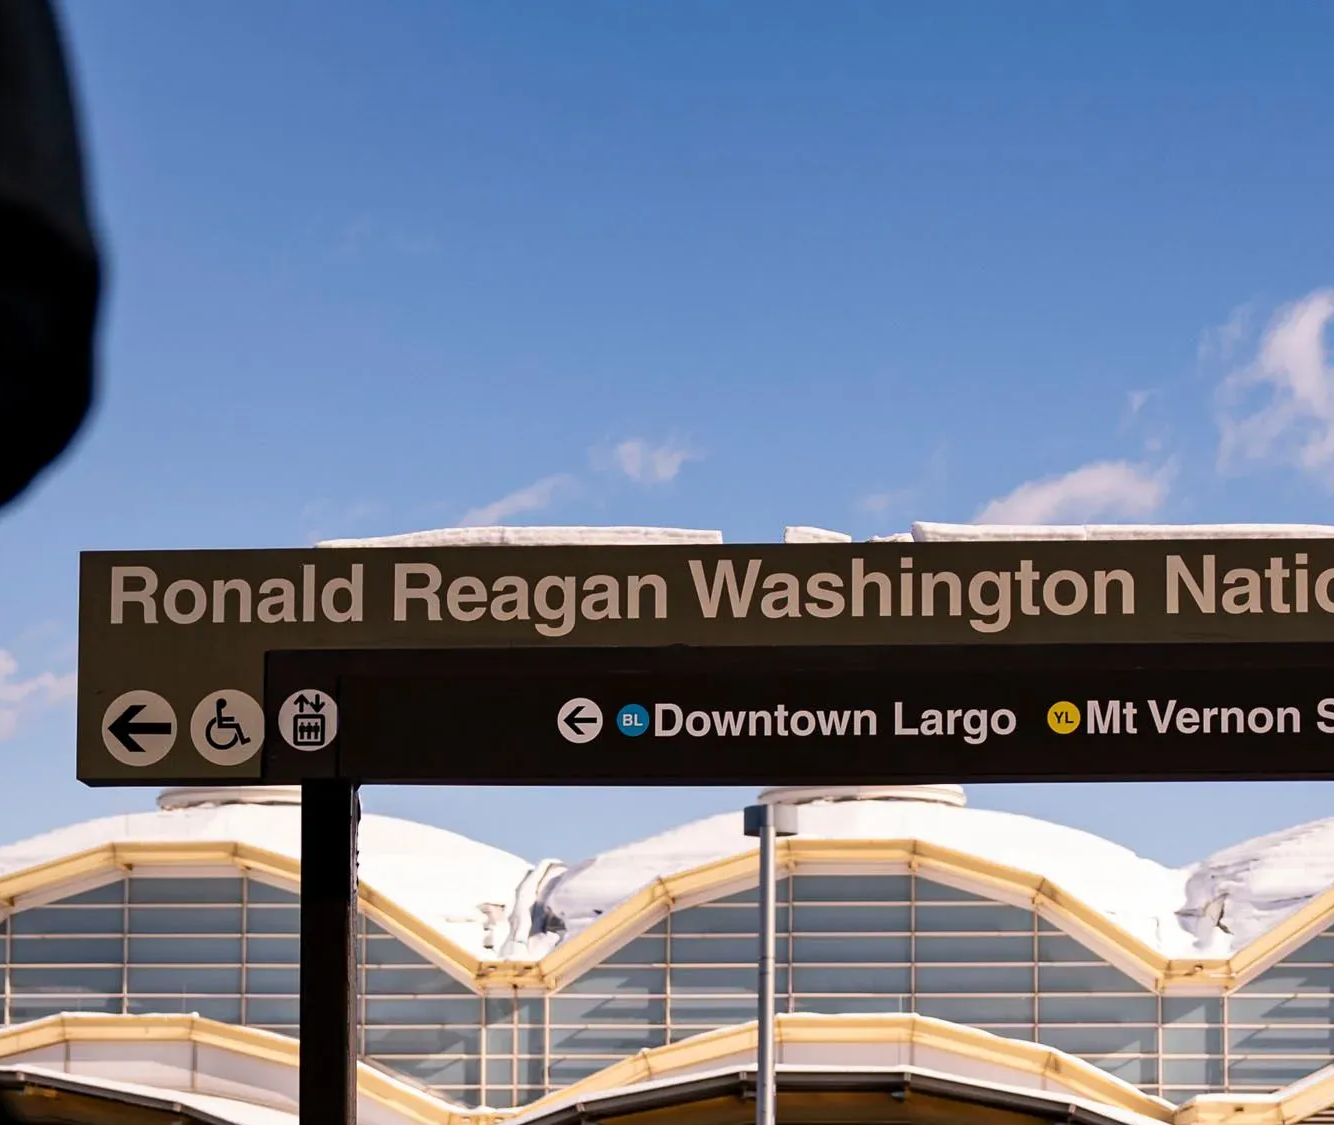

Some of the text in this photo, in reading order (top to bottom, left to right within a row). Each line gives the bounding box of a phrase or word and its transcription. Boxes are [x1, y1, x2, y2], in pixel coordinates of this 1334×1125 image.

[110, 564, 364, 625] Ronald
[393, 561, 666, 637] Reagan
[687, 556, 1135, 633] Washington
[622, 702, 1017, 745] BL Downtown Largo
[1054, 711, 1074, 724] YL
[1086, 699, 1138, 735] Mt
[1147, 699, 1301, 734] Vernon
